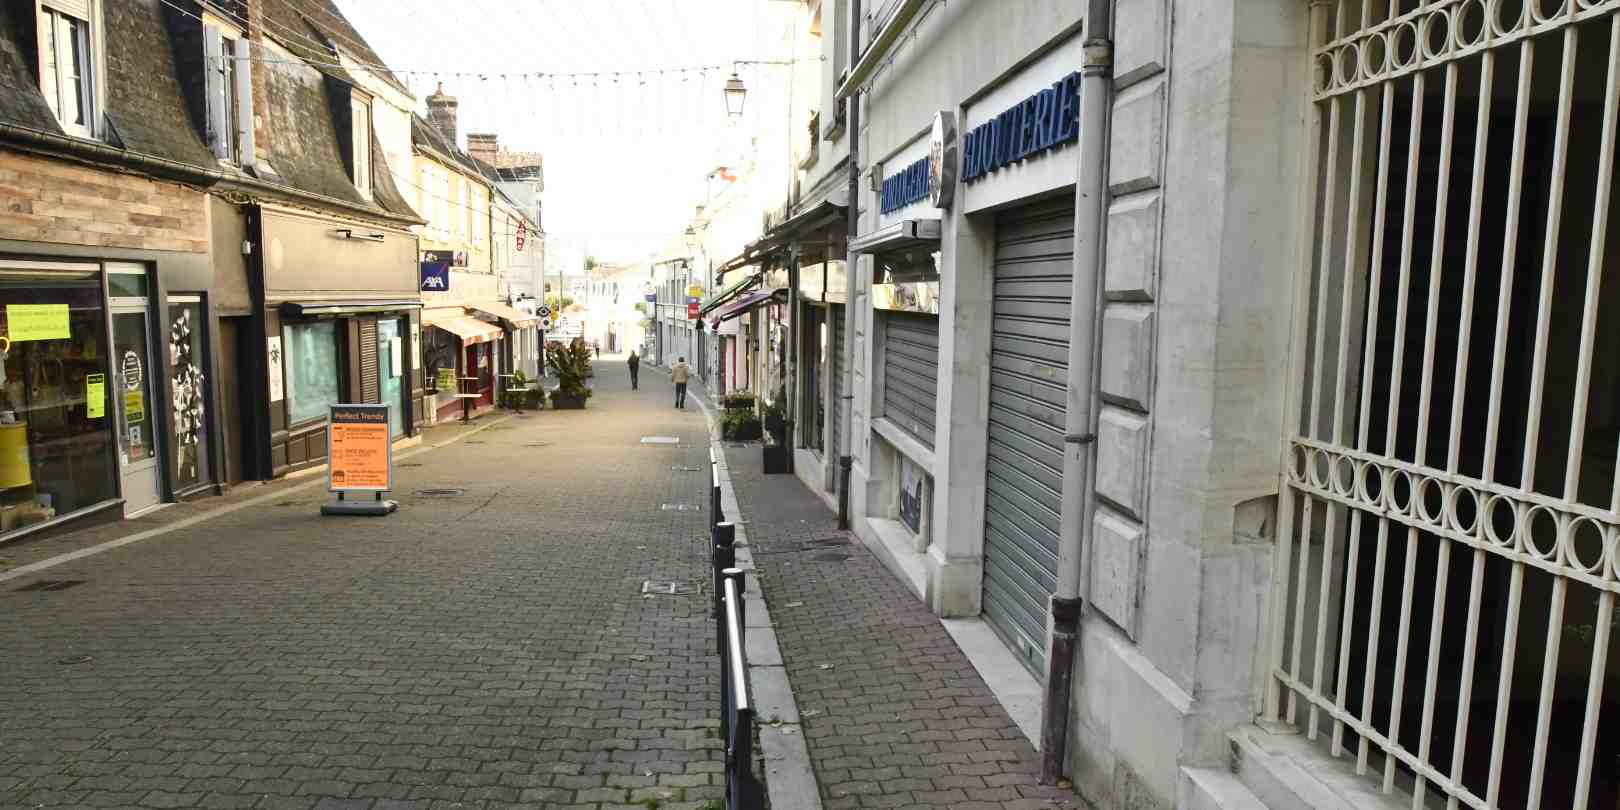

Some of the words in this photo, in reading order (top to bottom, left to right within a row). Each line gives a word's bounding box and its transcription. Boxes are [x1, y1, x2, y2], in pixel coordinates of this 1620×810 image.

[961, 71, 1081, 183] BIJOUTERIE
[881, 157, 930, 214] HORLOGERI
[422, 276, 444, 288] AXA
